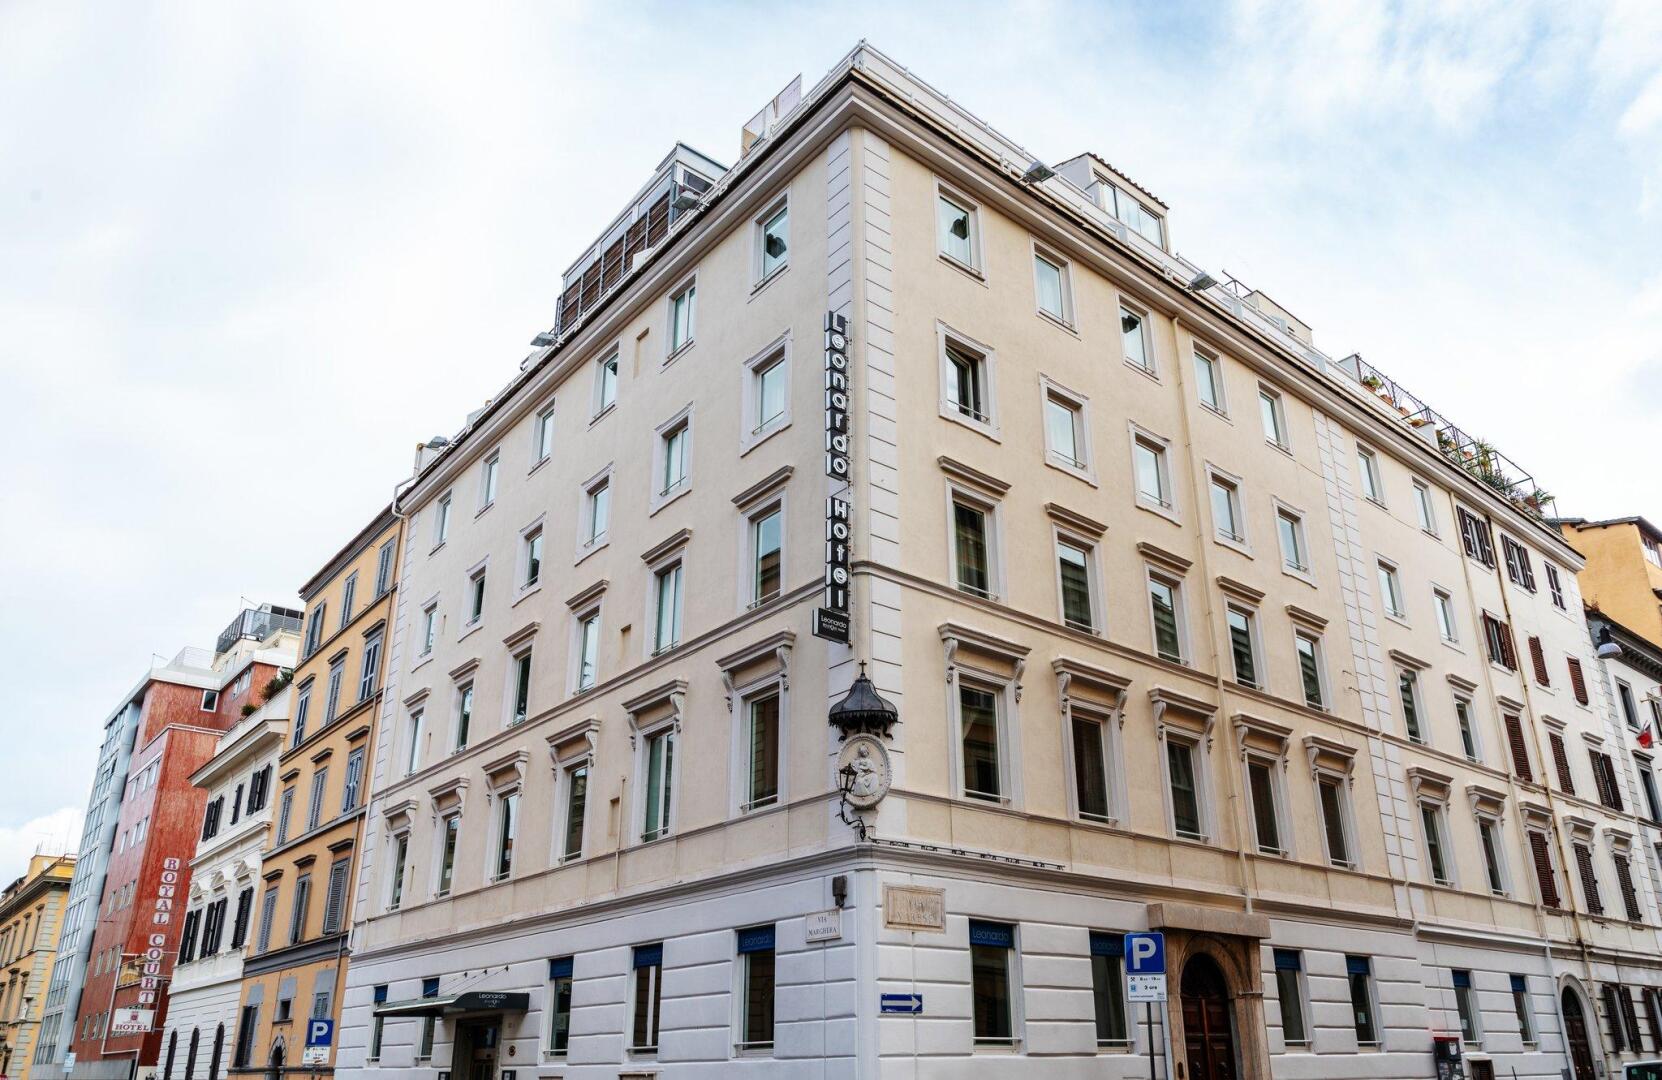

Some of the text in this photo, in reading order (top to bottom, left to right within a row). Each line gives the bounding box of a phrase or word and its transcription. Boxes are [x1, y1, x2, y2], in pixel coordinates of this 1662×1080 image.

[831, 312, 847, 474] Leonardo
[833, 499, 848, 608] Hotel
[820, 614, 847, 629] Leonardo
[140, 858, 178, 1003] ROYAL COURT
[1131, 937, 1157, 970] P
[114, 1023, 150, 1032] HOTEL
[311, 1021, 329, 1043] P
